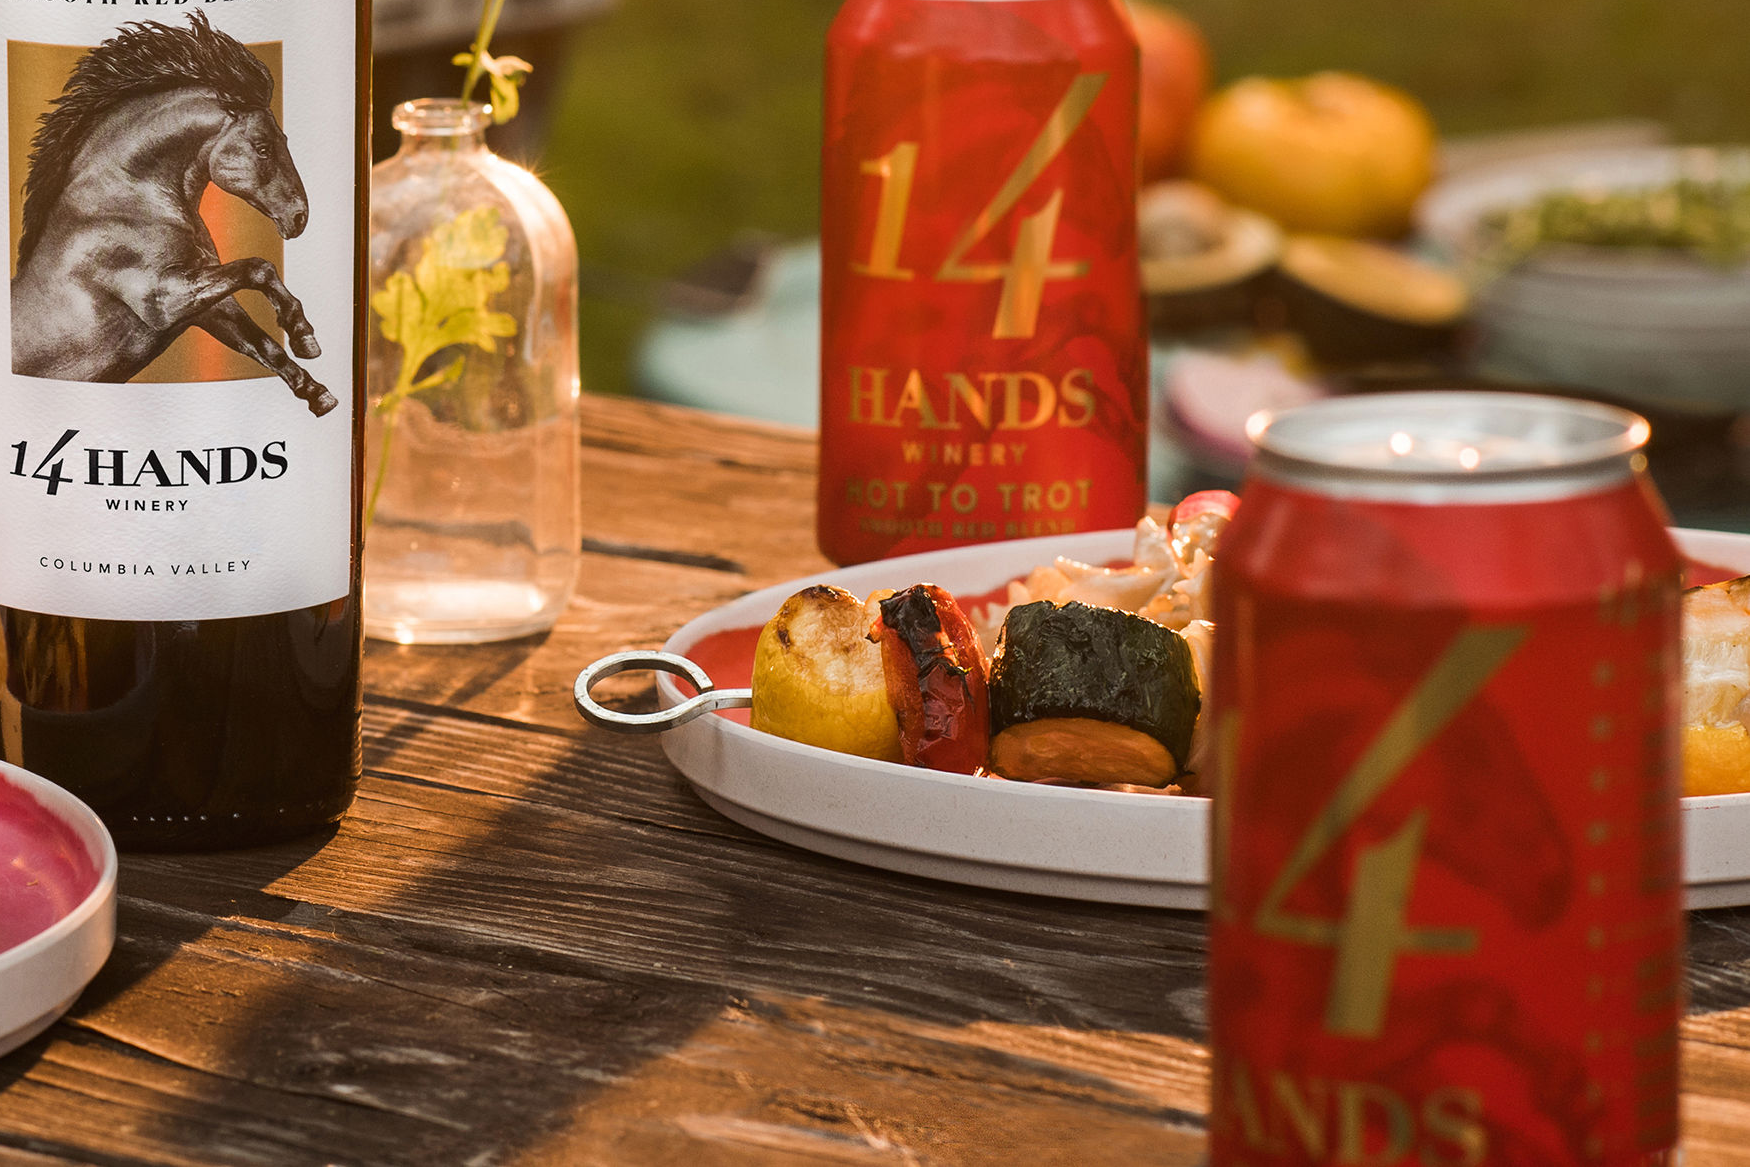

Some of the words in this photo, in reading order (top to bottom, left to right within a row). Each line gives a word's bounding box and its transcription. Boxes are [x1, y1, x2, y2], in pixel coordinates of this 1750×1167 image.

[851, 71, 1110, 340] 14
[847, 366, 1097, 431] HANDS
[9, 428, 80, 496] 14
[83, 440, 288, 487] HANDS
[902, 440, 1028, 467] WINERY
[105, 498, 189, 512] WINERY
[846, 476, 909, 511] HOT
[927, 482, 979, 514] TO
[997, 479, 1093, 513] TROT
[39, 556, 155, 575] COLUMBIA
[170, 559, 250, 575] VALLEY
